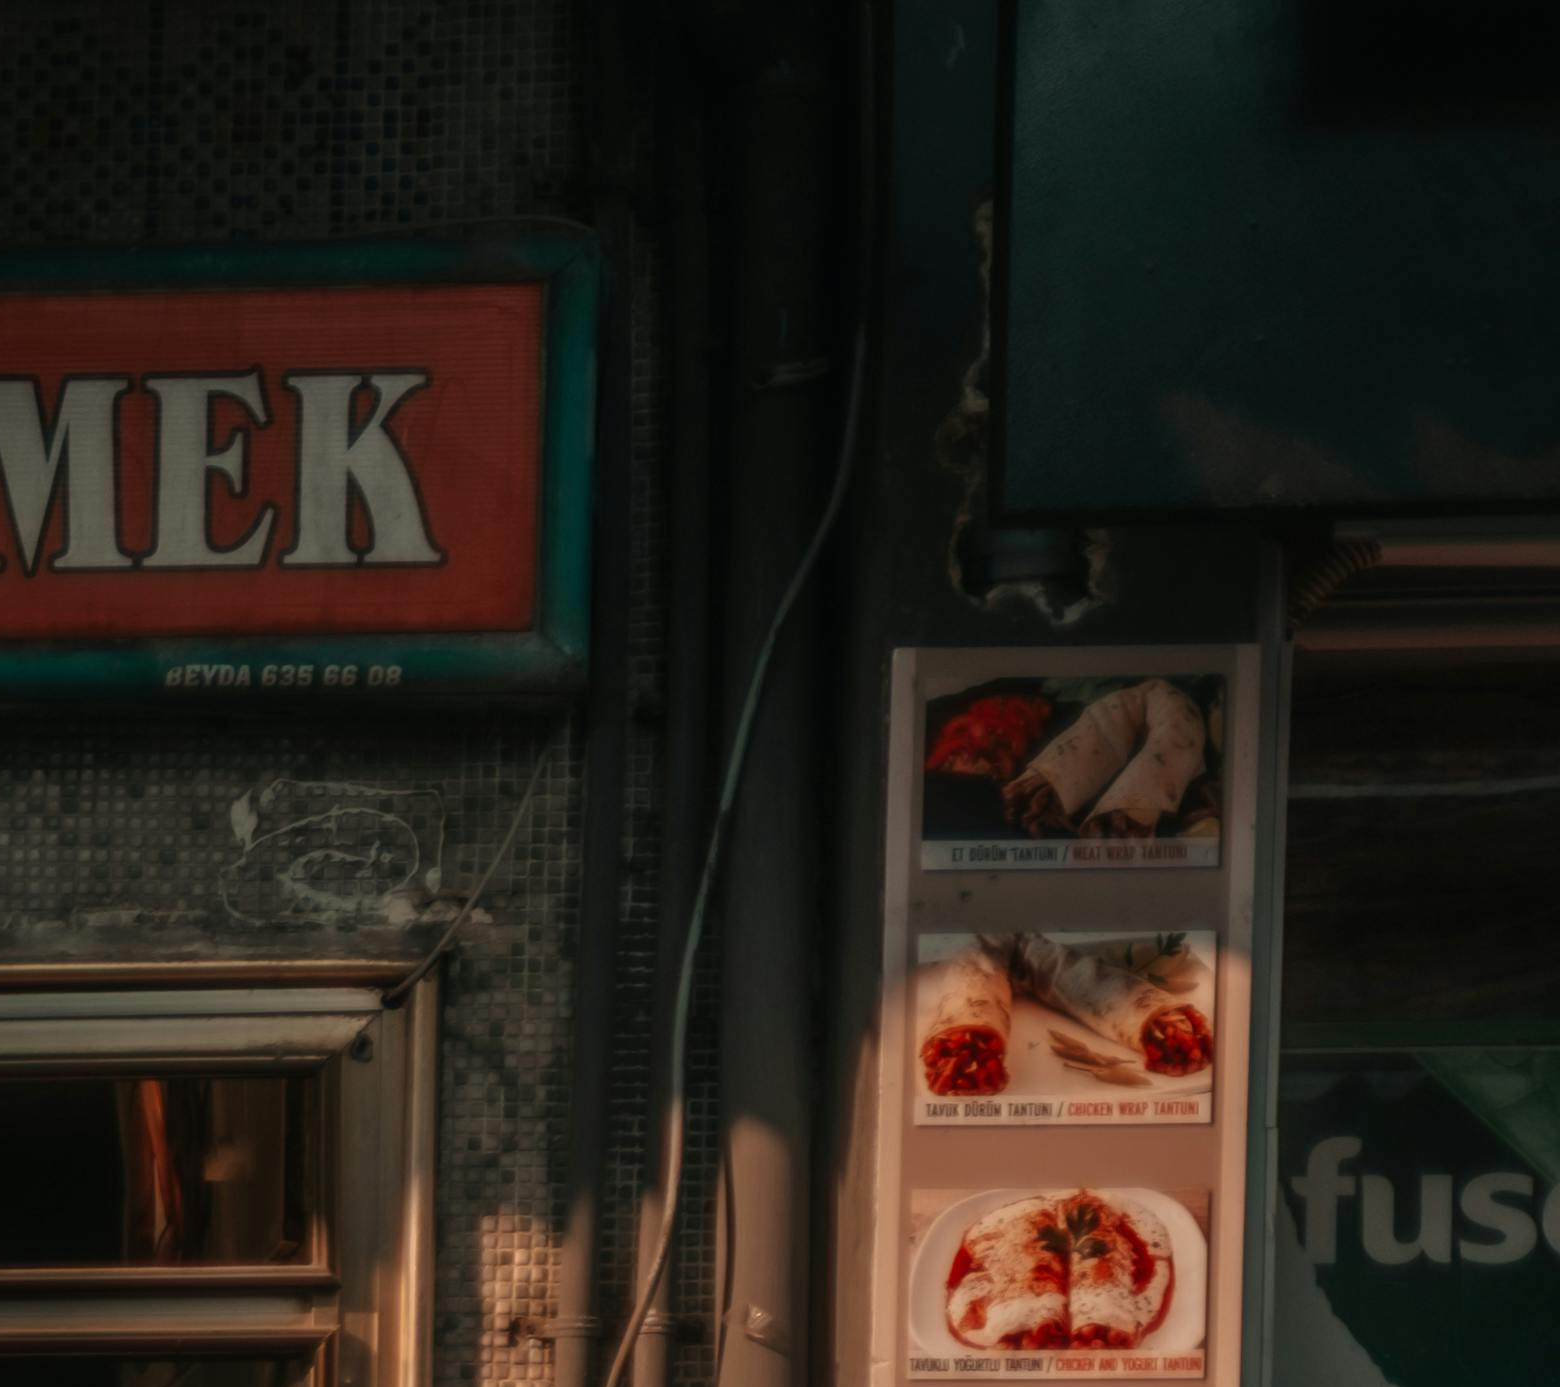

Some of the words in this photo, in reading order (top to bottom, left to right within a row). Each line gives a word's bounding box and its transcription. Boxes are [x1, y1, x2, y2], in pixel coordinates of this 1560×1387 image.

[164, 663, 252, 688] BEYDA
[260, 663, 314, 688] 635
[322, 664, 360, 688] 66
[366, 664, 403, 688] 08
[1072, 846, 1100, 861] MEAT
[1106, 846, 1136, 861] WRAP
[926, 1103, 958, 1117] TAVUK
[1067, 1102, 1112, 1116] CHICKEN
[1118, 1102, 1148, 1116] WRAP
[1290, 1135, 1560, 1265] fus
[1055, 1358, 1094, 1372] CHICKEN
[1098, 1358, 1118, 1372] AND
[1121, 1358, 1158, 1372] YOGURT
